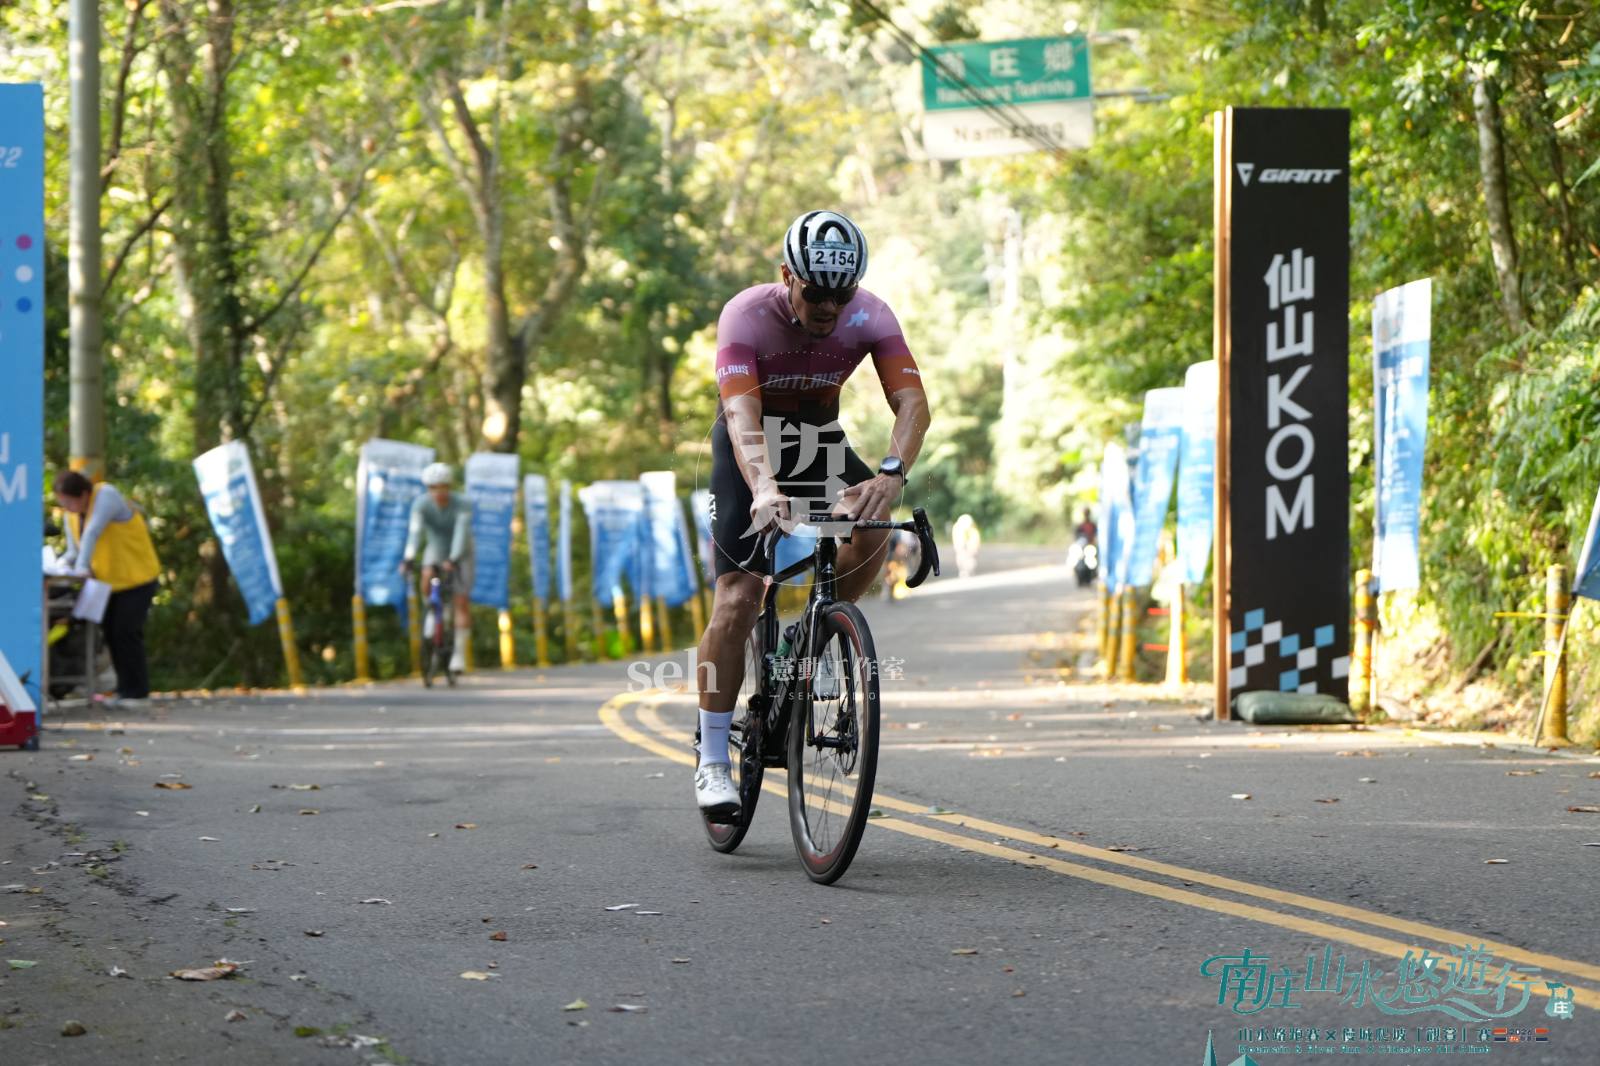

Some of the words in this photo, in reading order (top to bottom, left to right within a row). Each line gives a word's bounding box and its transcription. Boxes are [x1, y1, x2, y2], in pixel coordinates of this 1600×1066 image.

[1258, 168, 1342, 184] GIANT
[815, 250, 855, 267] 2154
[1264, 364, 1316, 541] KOM
